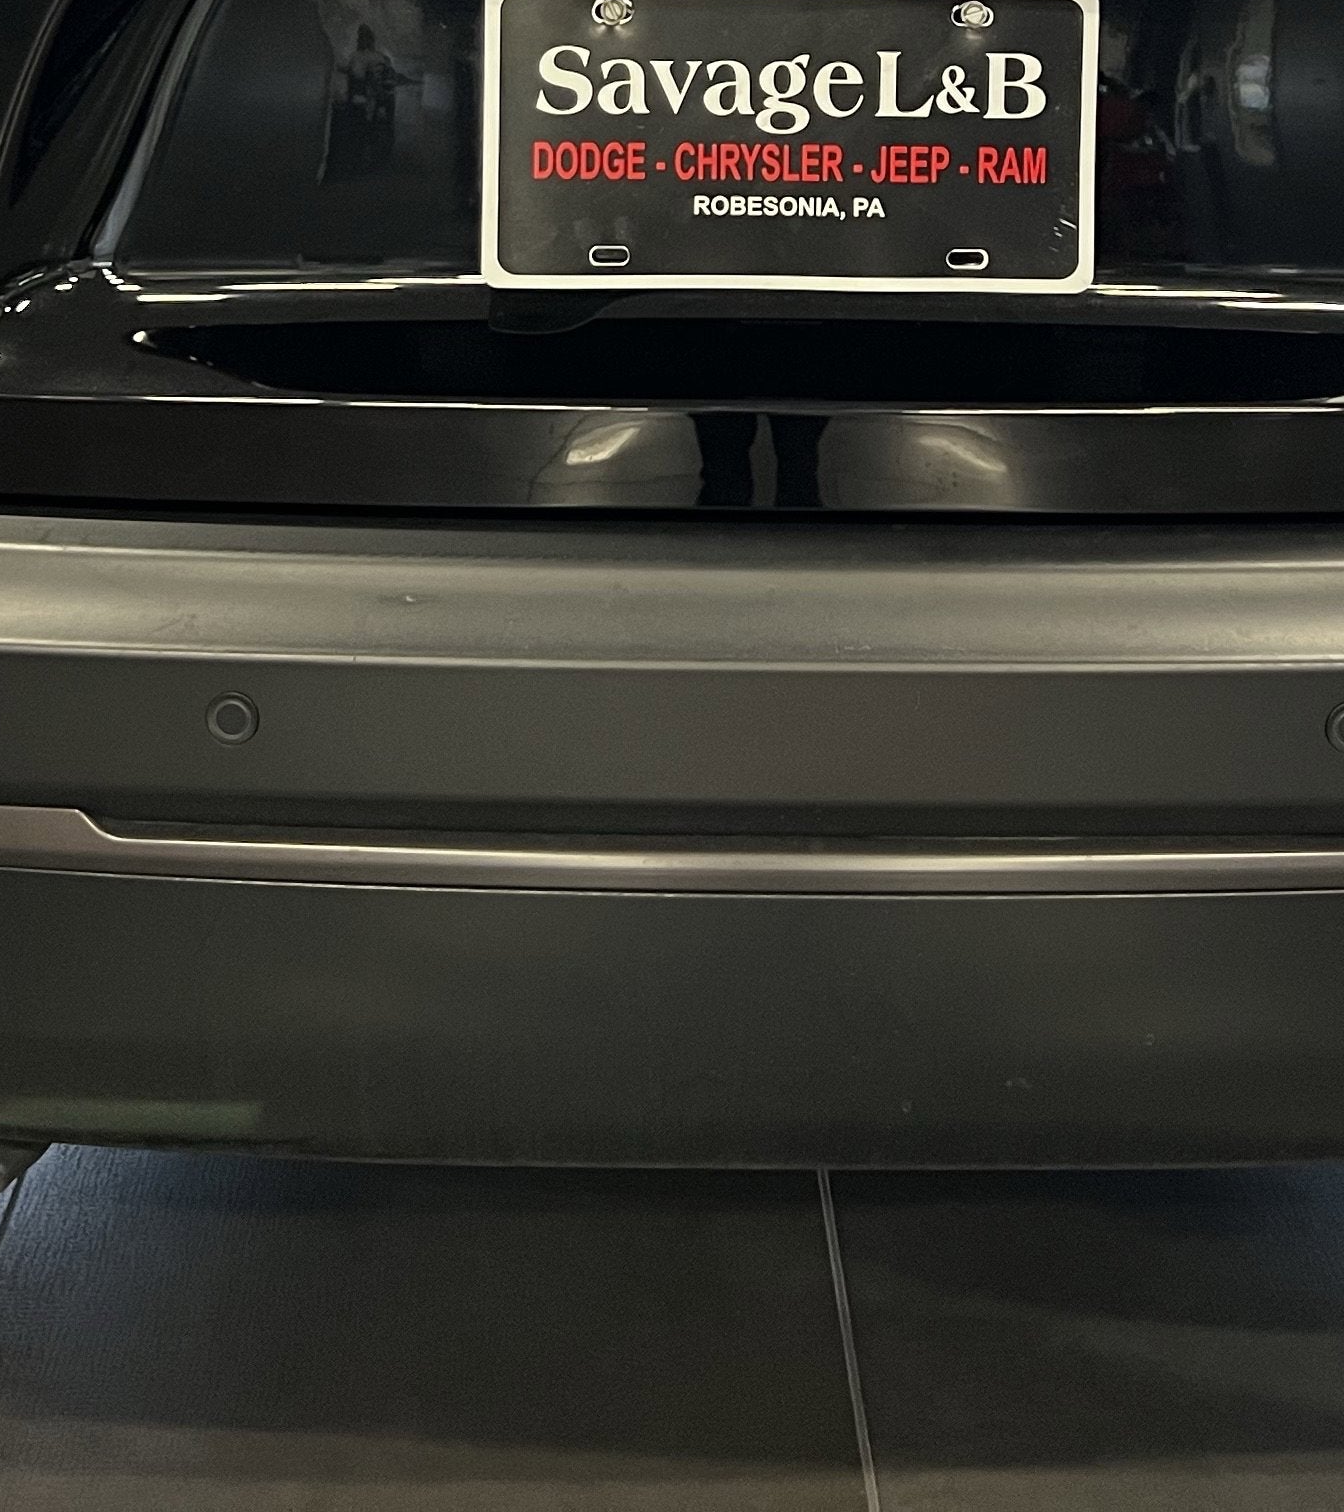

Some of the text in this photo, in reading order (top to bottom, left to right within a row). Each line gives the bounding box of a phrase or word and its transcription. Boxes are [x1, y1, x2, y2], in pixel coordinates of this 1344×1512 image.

[535, 45, 1047, 135] Savage L&B
[531, 140, 646, 181] DODGE
[673, 141, 844, 183] CHRYSLER
[869, 144, 951, 185] JEEP
[976, 145, 1048, 185] RAM
[693, 194, 886, 221] ROBESONIA, PA
